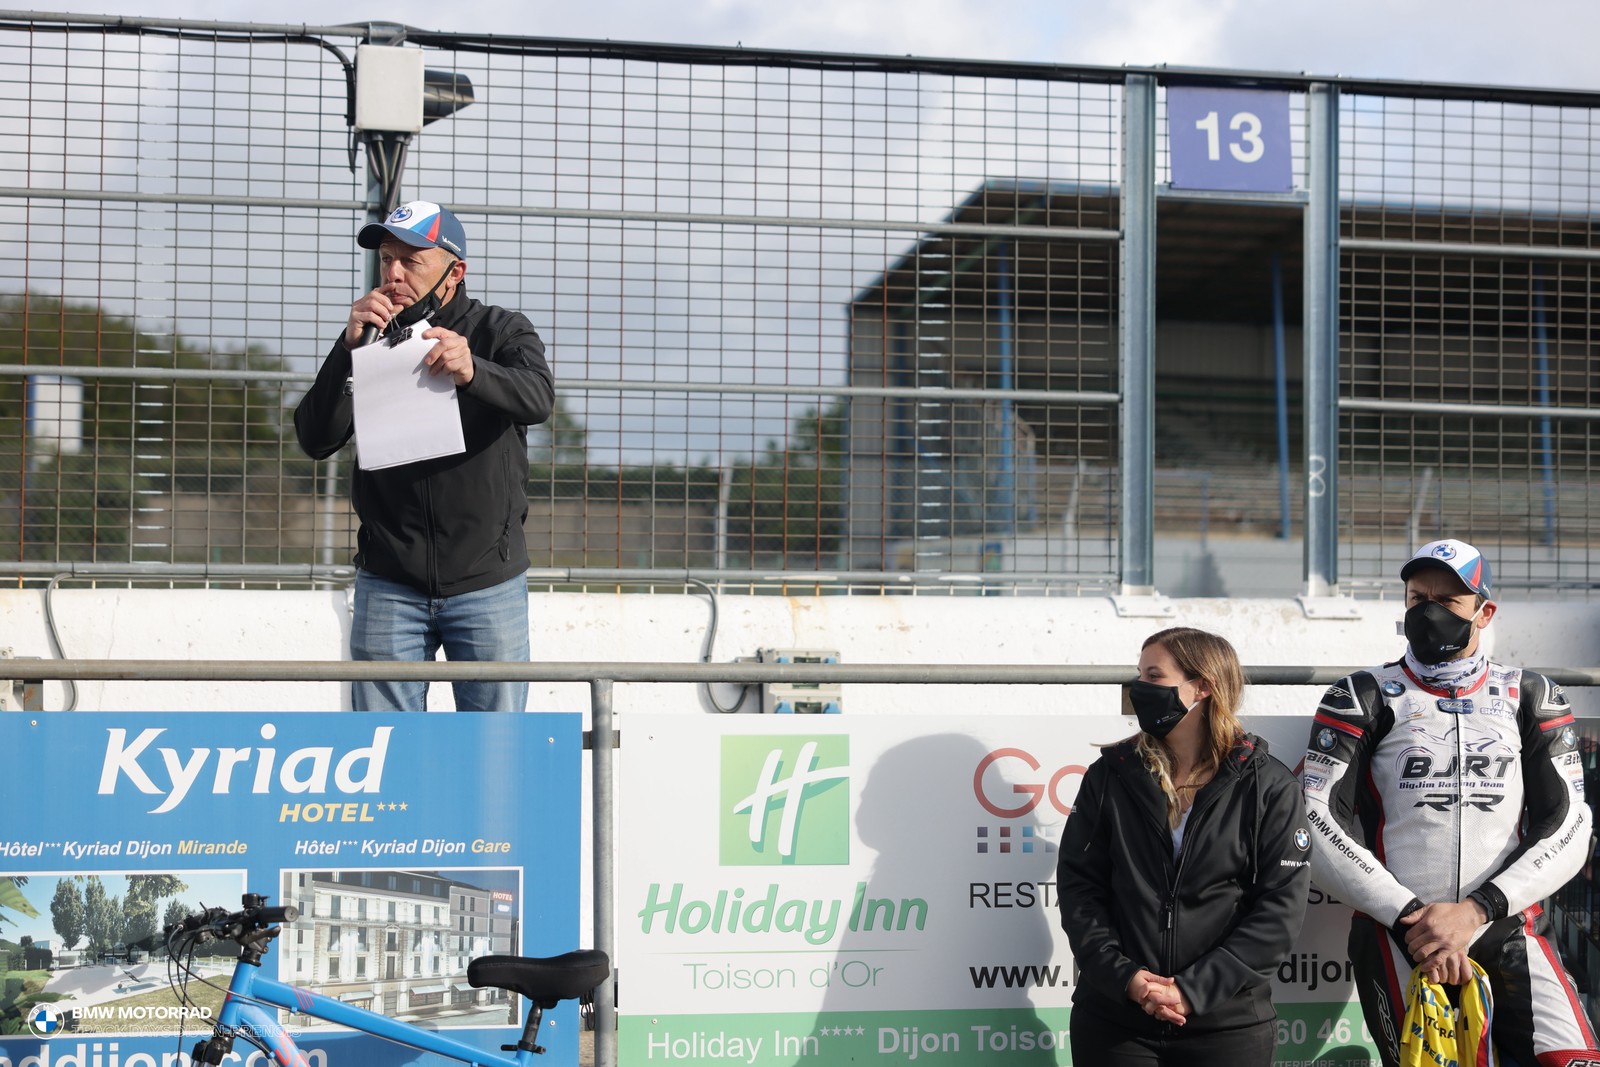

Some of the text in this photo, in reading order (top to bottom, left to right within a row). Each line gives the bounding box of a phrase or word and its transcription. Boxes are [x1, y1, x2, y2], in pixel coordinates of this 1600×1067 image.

[1196, 111, 1264, 163] 13
[98, 723, 394, 814] Kyriad
[1306, 751, 1341, 766] Bihr
[1400, 754, 1516, 779] BJRT
[1399, 781, 1435, 789] BigJim
[279, 803, 375, 823] HOTEL
[63, 840, 122, 859] Kyriad
[126, 840, 172, 858] Dijon
[178, 840, 248, 855] Mirande
[295, 839, 511, 858] Hôtel Kyriad Dijon Gare
[1307, 810, 1375, 875] BMW Motorrad
[493, 892, 513, 901] HOTEL
[969, 882, 1059, 908] REST
[638, 881, 928, 945] Holiday Inn
[683, 961, 884, 990] Toison d'Or
[1317, 1018, 1352, 1044] 46
[648, 1030, 762, 1064] Holiday
[775, 1030, 819, 1057] Inn
[878, 1027, 960, 1060] Dijon
